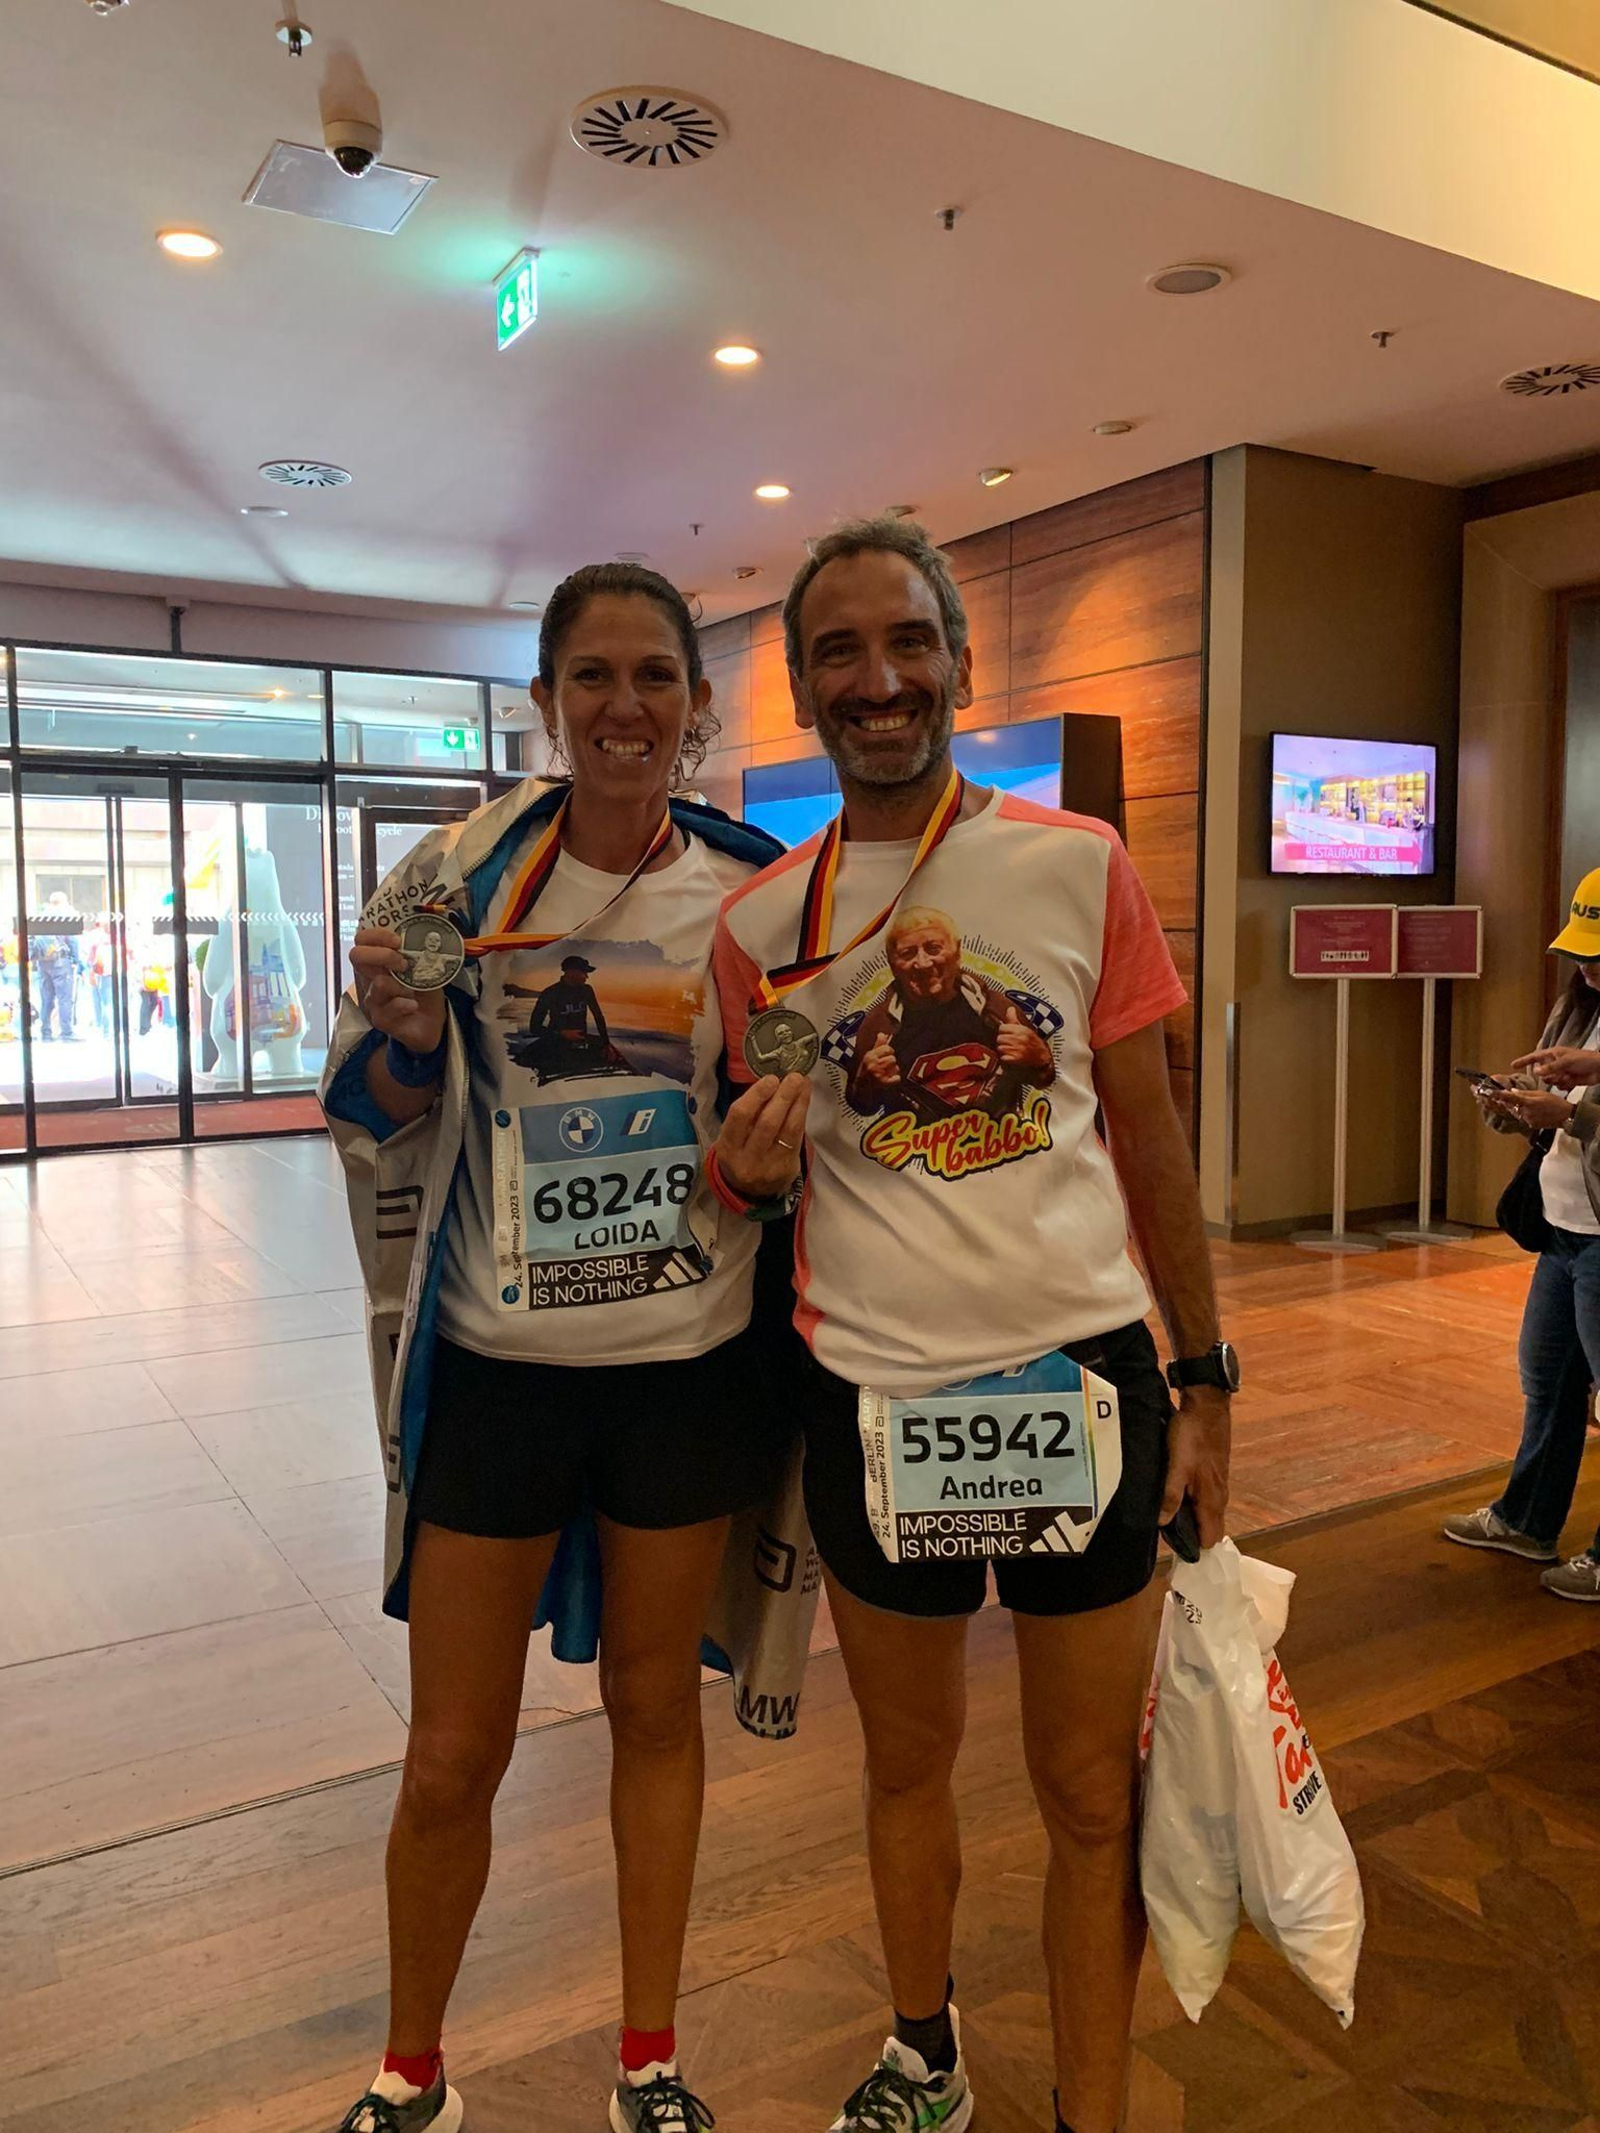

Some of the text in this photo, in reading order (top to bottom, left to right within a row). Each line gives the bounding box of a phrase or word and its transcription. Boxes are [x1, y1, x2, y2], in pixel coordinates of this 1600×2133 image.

[1305, 846, 1398, 861] RESTAURANT & BAR
[866, 1111, 985, 1166] Super
[533, 1163, 695, 1224] 68248
[509, 1195, 524, 1288] 24. September 2023
[574, 1219, 661, 1250] LOIDA
[532, 1254, 650, 1284] IMPOSSIBLE
[532, 1277, 648, 1306] IS NOTHING
[1096, 1400, 1112, 1419] D
[901, 1410, 1075, 1463] 55942
[875, 1431, 891, 1539] 24. September 2023
[939, 1474, 1043, 1500] Andrea
[900, 1511, 1028, 1535] IMPOSSIBLE
[901, 1535, 1024, 1558] IS NOTHING
